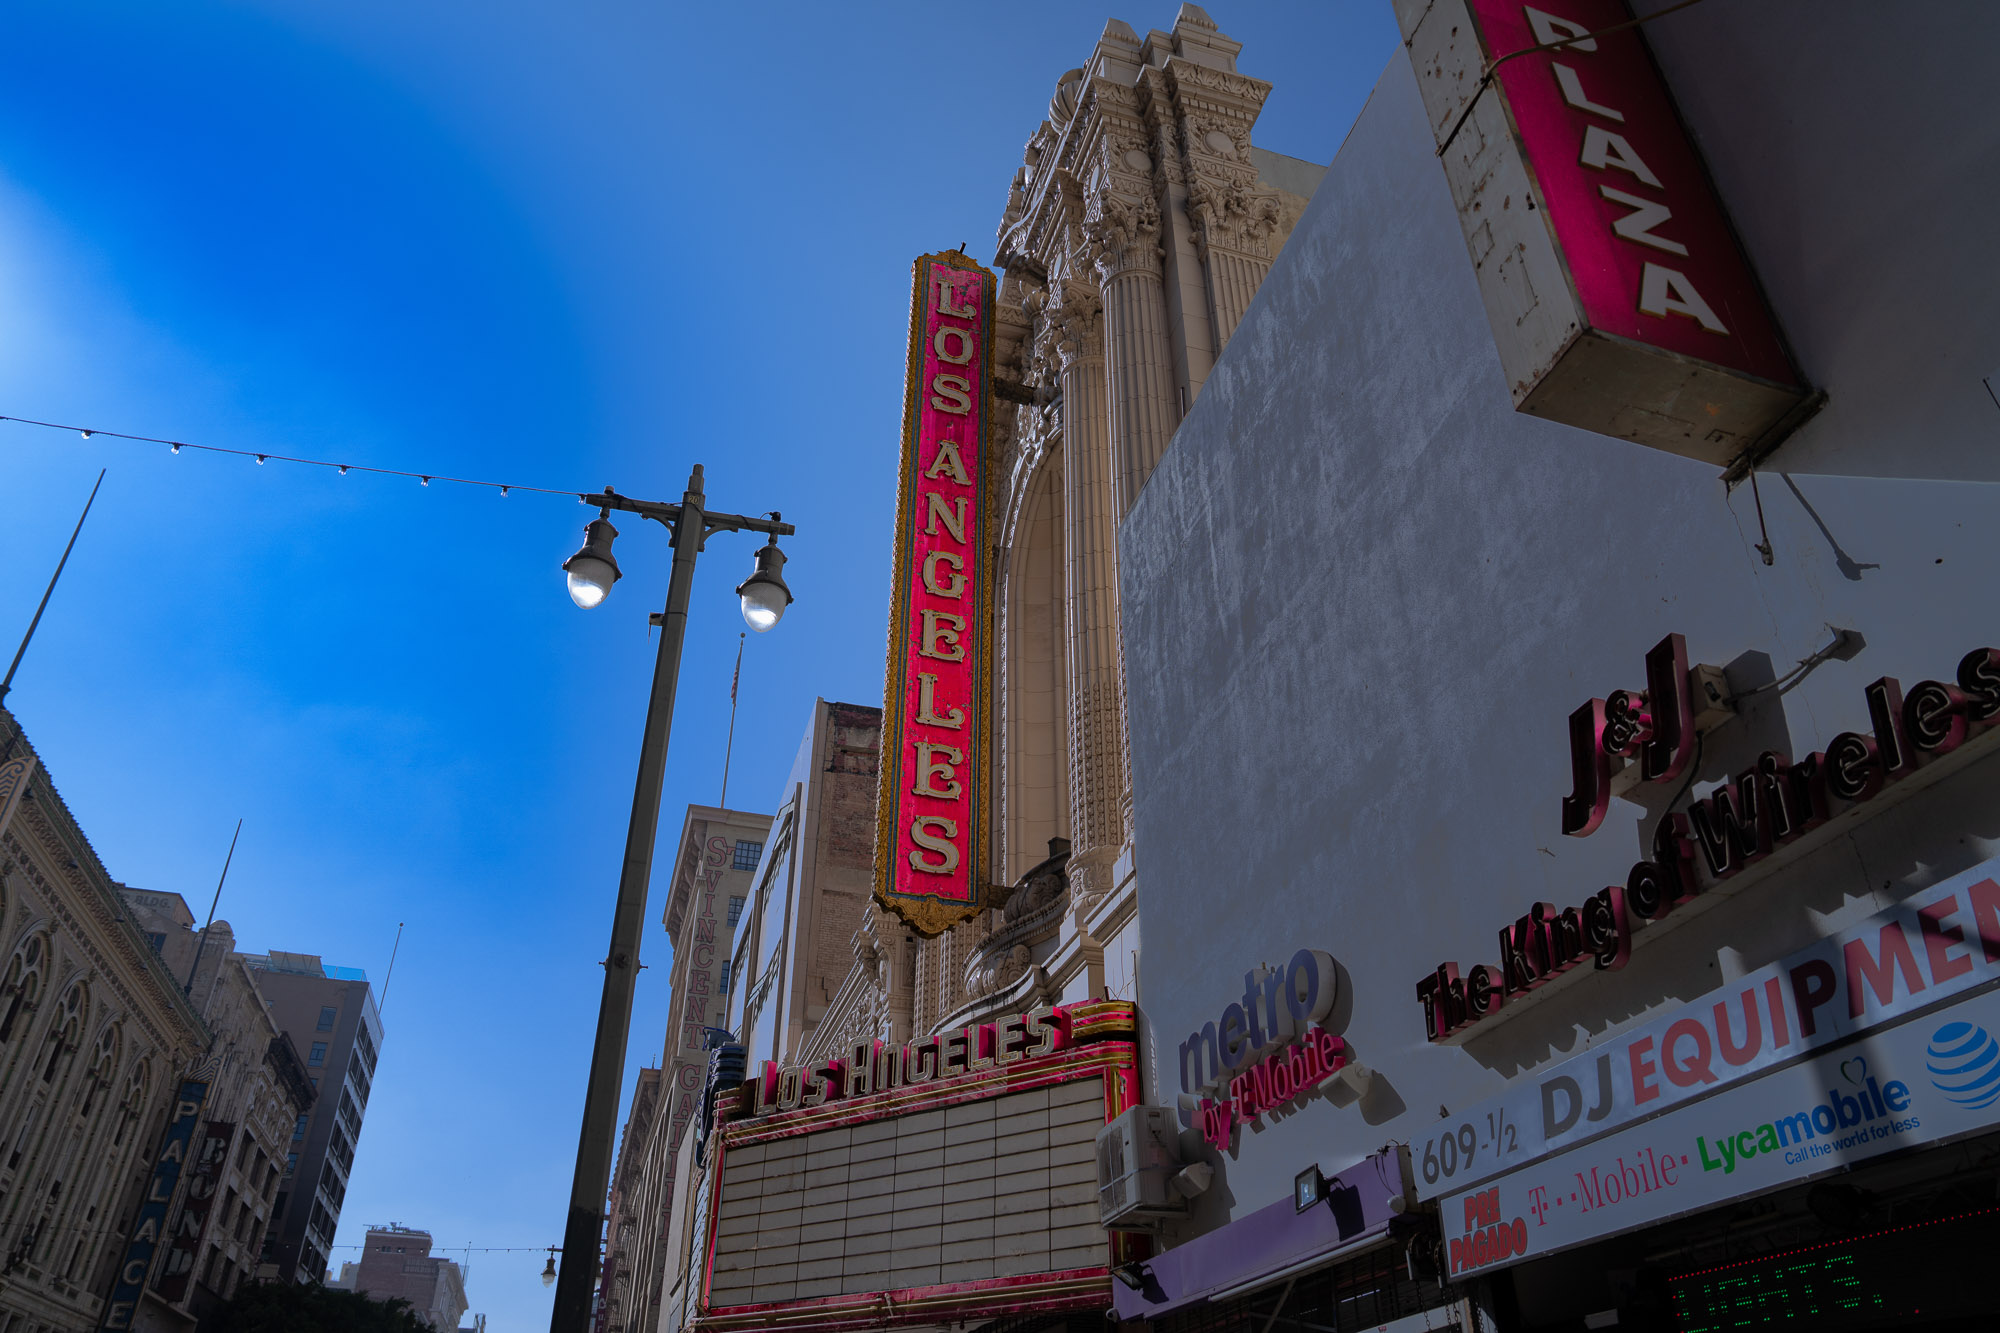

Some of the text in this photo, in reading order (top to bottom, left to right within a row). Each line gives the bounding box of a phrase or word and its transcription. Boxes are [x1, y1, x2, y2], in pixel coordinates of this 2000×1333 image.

[1522, 4, 1730, 337] PLAZA
[907, 277, 977, 876] LOS ANGELES
[1561, 632, 1694, 838] J&J
[684, 869, 723, 1049] VINCENT
[1416, 961, 1503, 1043] The
[1498, 885, 1631, 997] King
[1627, 812, 1697, 921] of
[1178, 948, 1334, 1098] metro
[1199, 1098, 1233, 1151] by
[1540, 1053, 1613, 1140] DJ
[1696, 1074, 1911, 1175] Lycamobile
[1785, 1115, 1921, 1166] Call the world for less
[103, 1099, 199, 1330] PALACE
[164, 1136, 227, 1277] BOND
[1450, 1216, 1528, 1274] PAGADO
[1463, 1184, 1502, 1232] PRE
